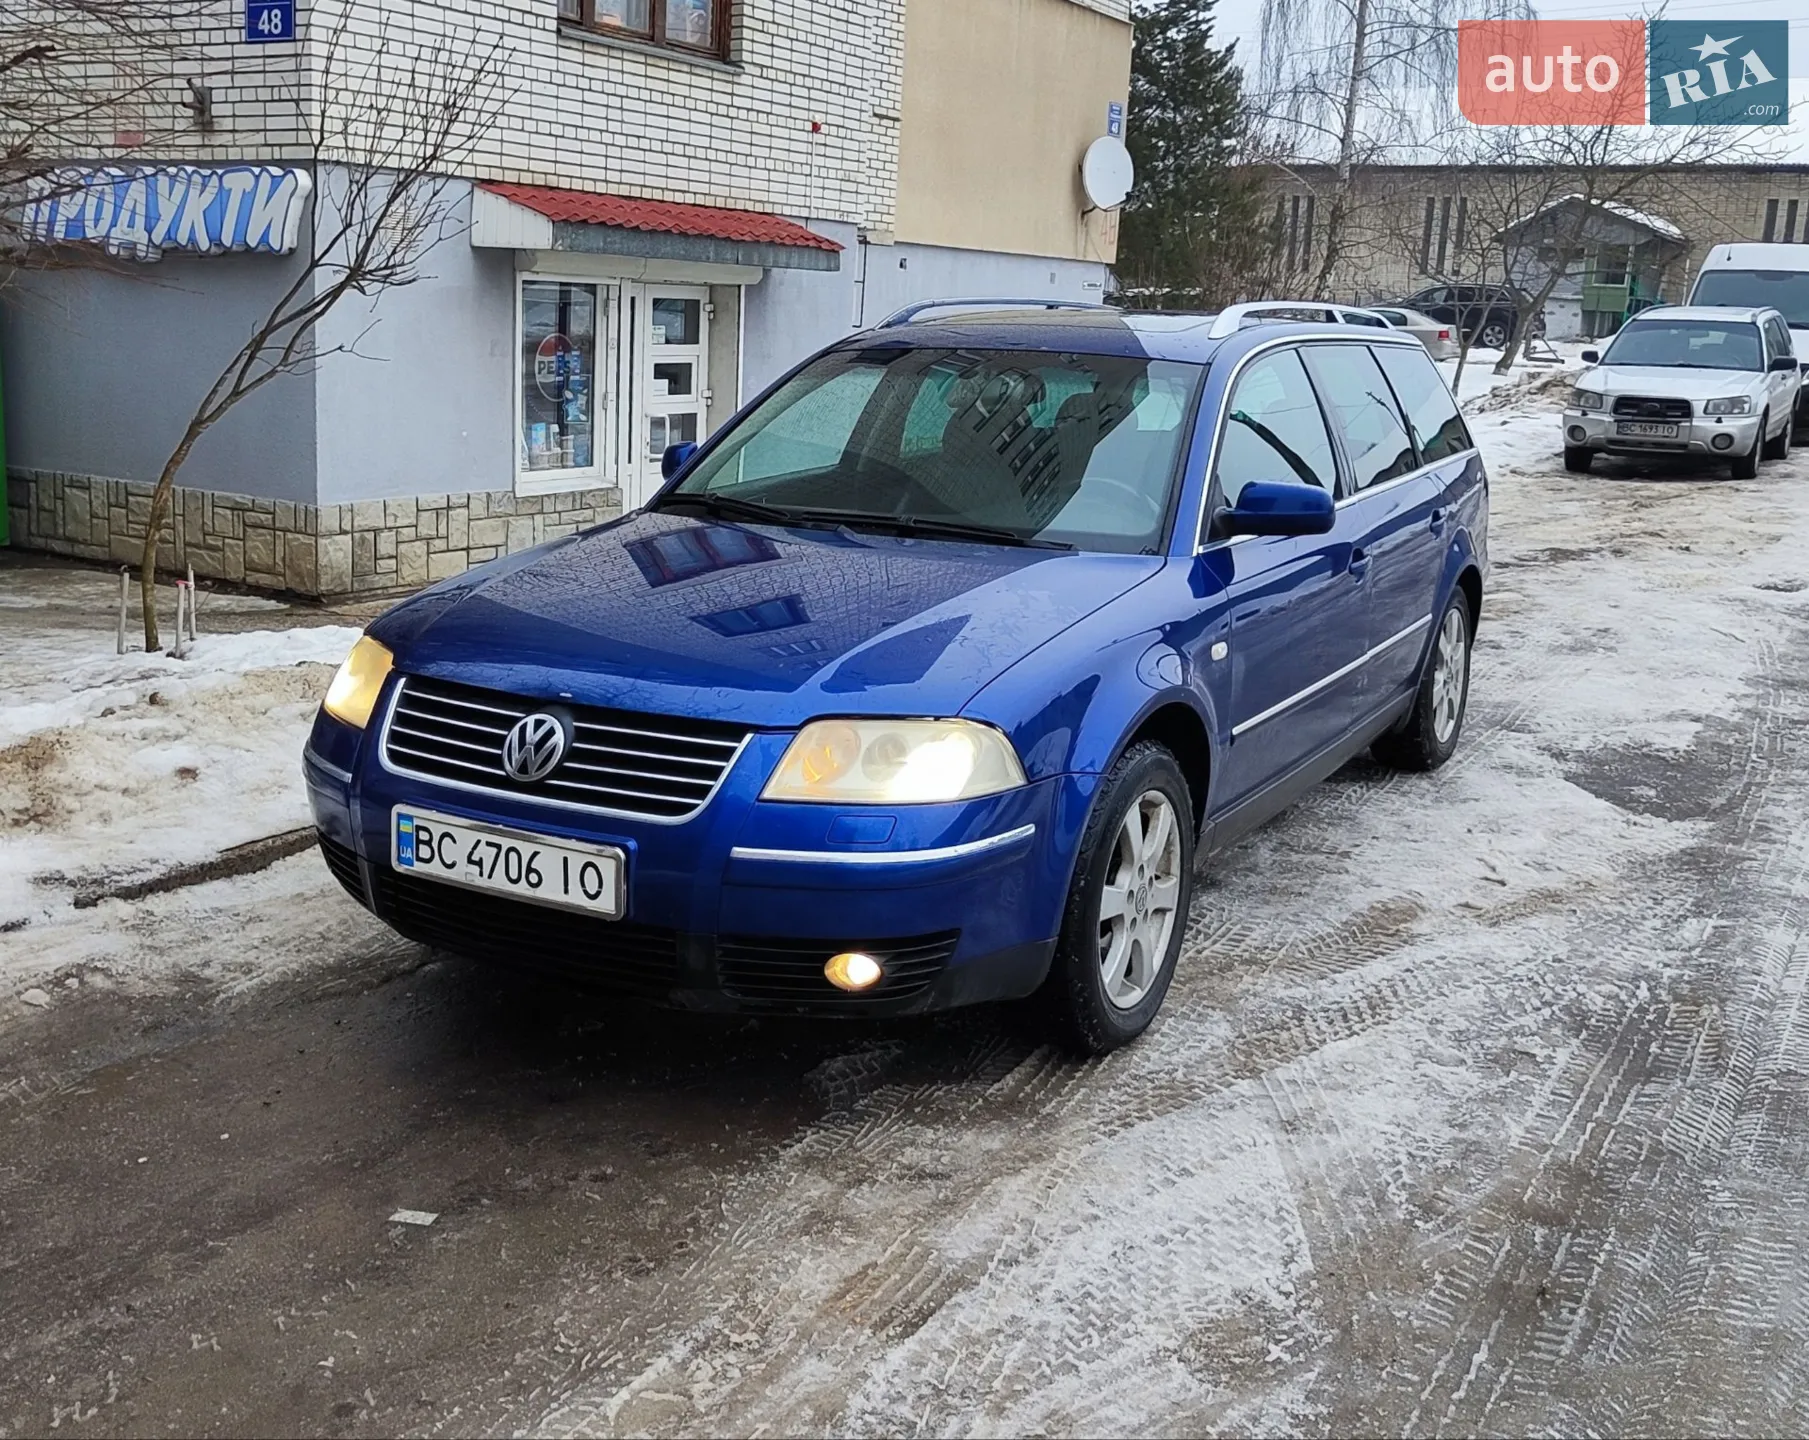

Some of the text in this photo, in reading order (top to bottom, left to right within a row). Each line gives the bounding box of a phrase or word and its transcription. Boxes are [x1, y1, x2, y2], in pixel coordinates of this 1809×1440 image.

[258, 9, 282, 35] 48
[22, 166, 298, 257] ПРОДУКТИ
[1621, 423, 1637, 433] BC
[1639, 425, 1659, 434] 1693
[400, 847, 413, 860] UA
[414, 824, 604, 901] BC 4706 IO
